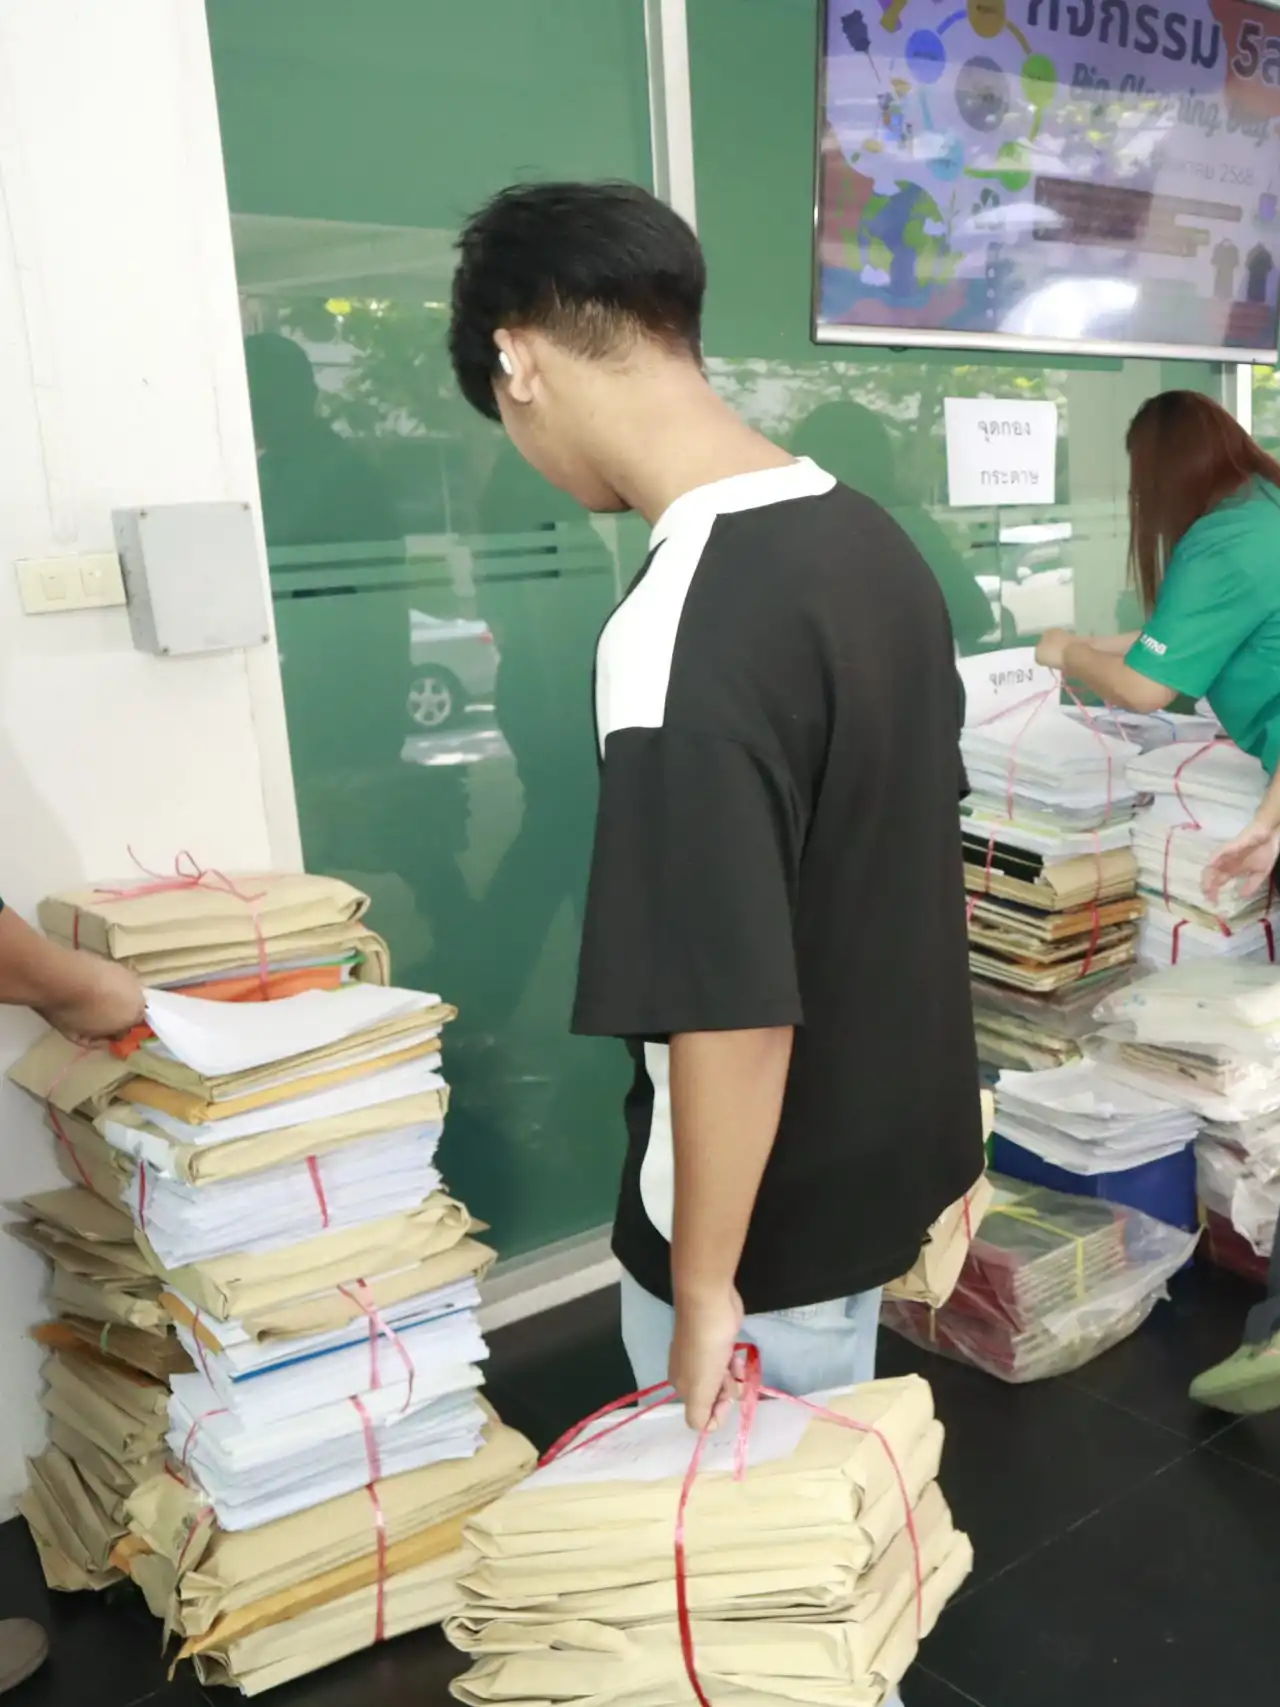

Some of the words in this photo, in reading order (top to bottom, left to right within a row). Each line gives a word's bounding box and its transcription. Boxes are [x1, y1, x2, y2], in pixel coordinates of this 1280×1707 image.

[1027, 0, 1222, 68] กจกรรม
[977, 420, 1032, 443] จุดกอง
[980, 470, 1039, 485] กระดาษ
[989, 668, 1034, 695] จุดกอง
